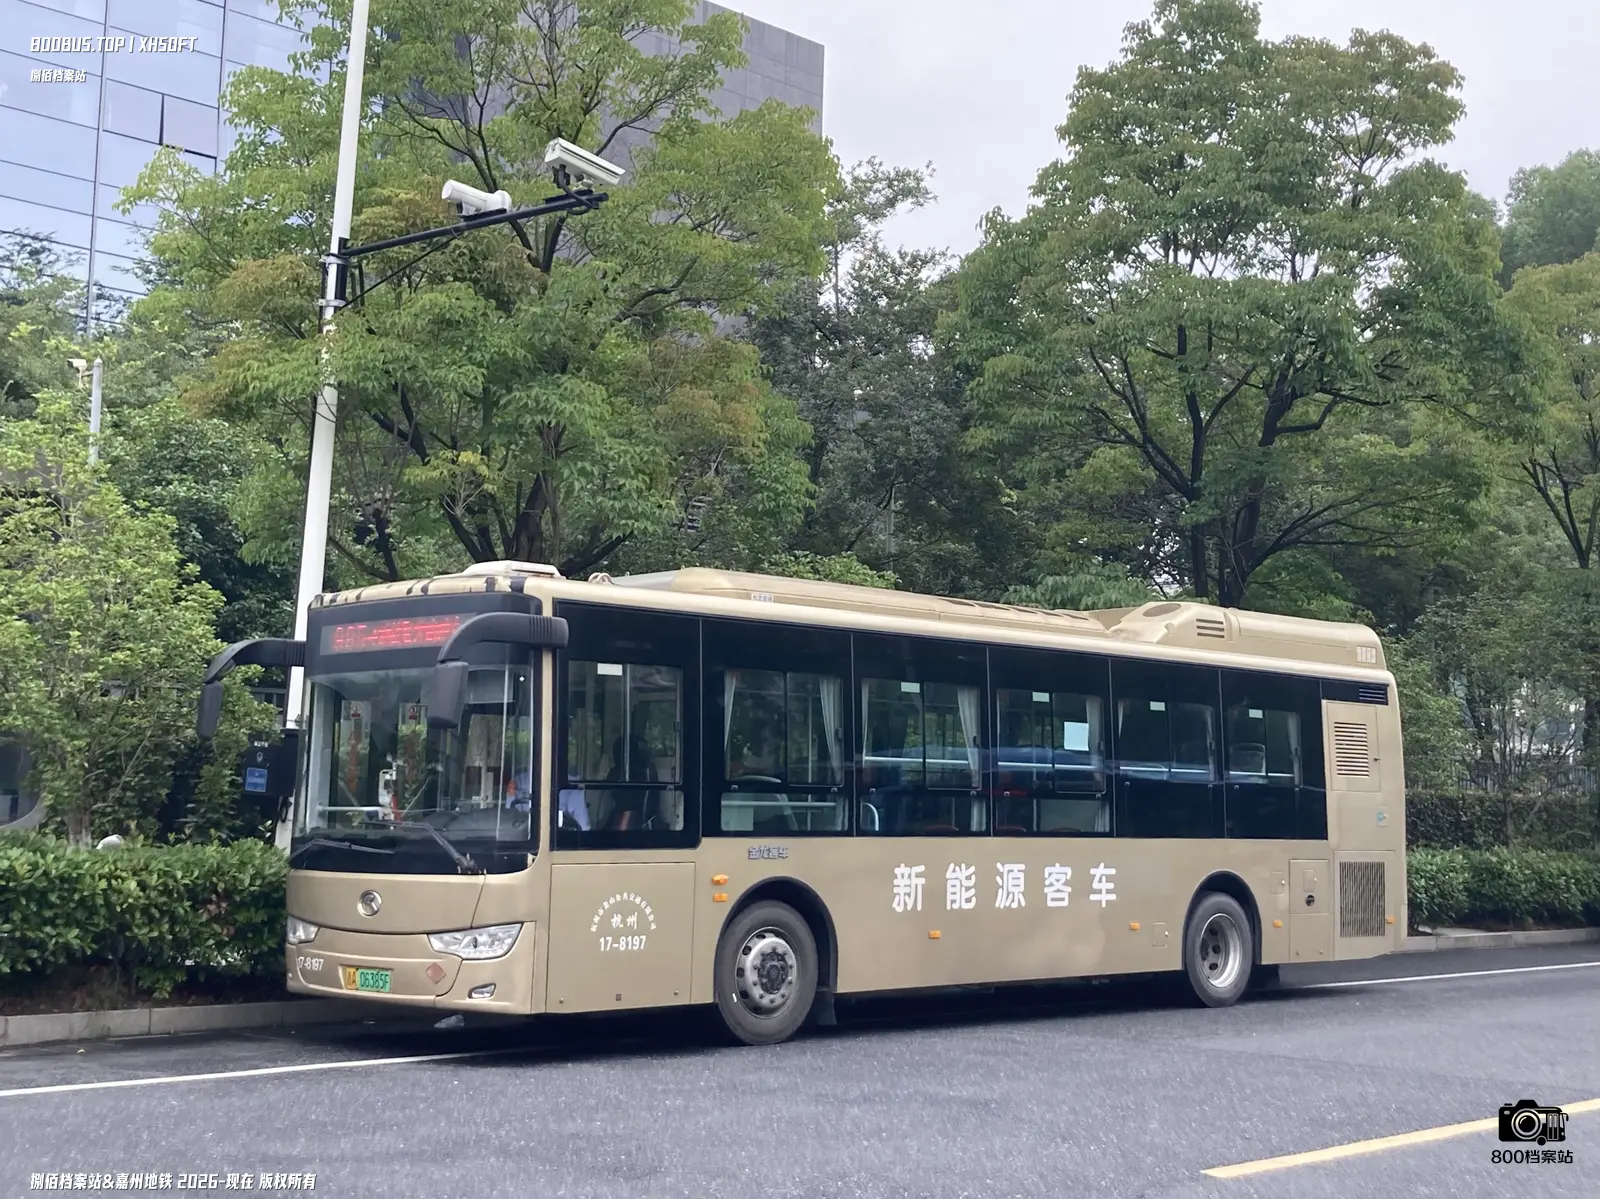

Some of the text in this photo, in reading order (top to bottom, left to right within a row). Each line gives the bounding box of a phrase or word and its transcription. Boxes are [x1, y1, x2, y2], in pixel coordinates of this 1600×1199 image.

[892, 862, 1117, 912] 新能源客车
[599, 935, 646, 952] 17-8197
